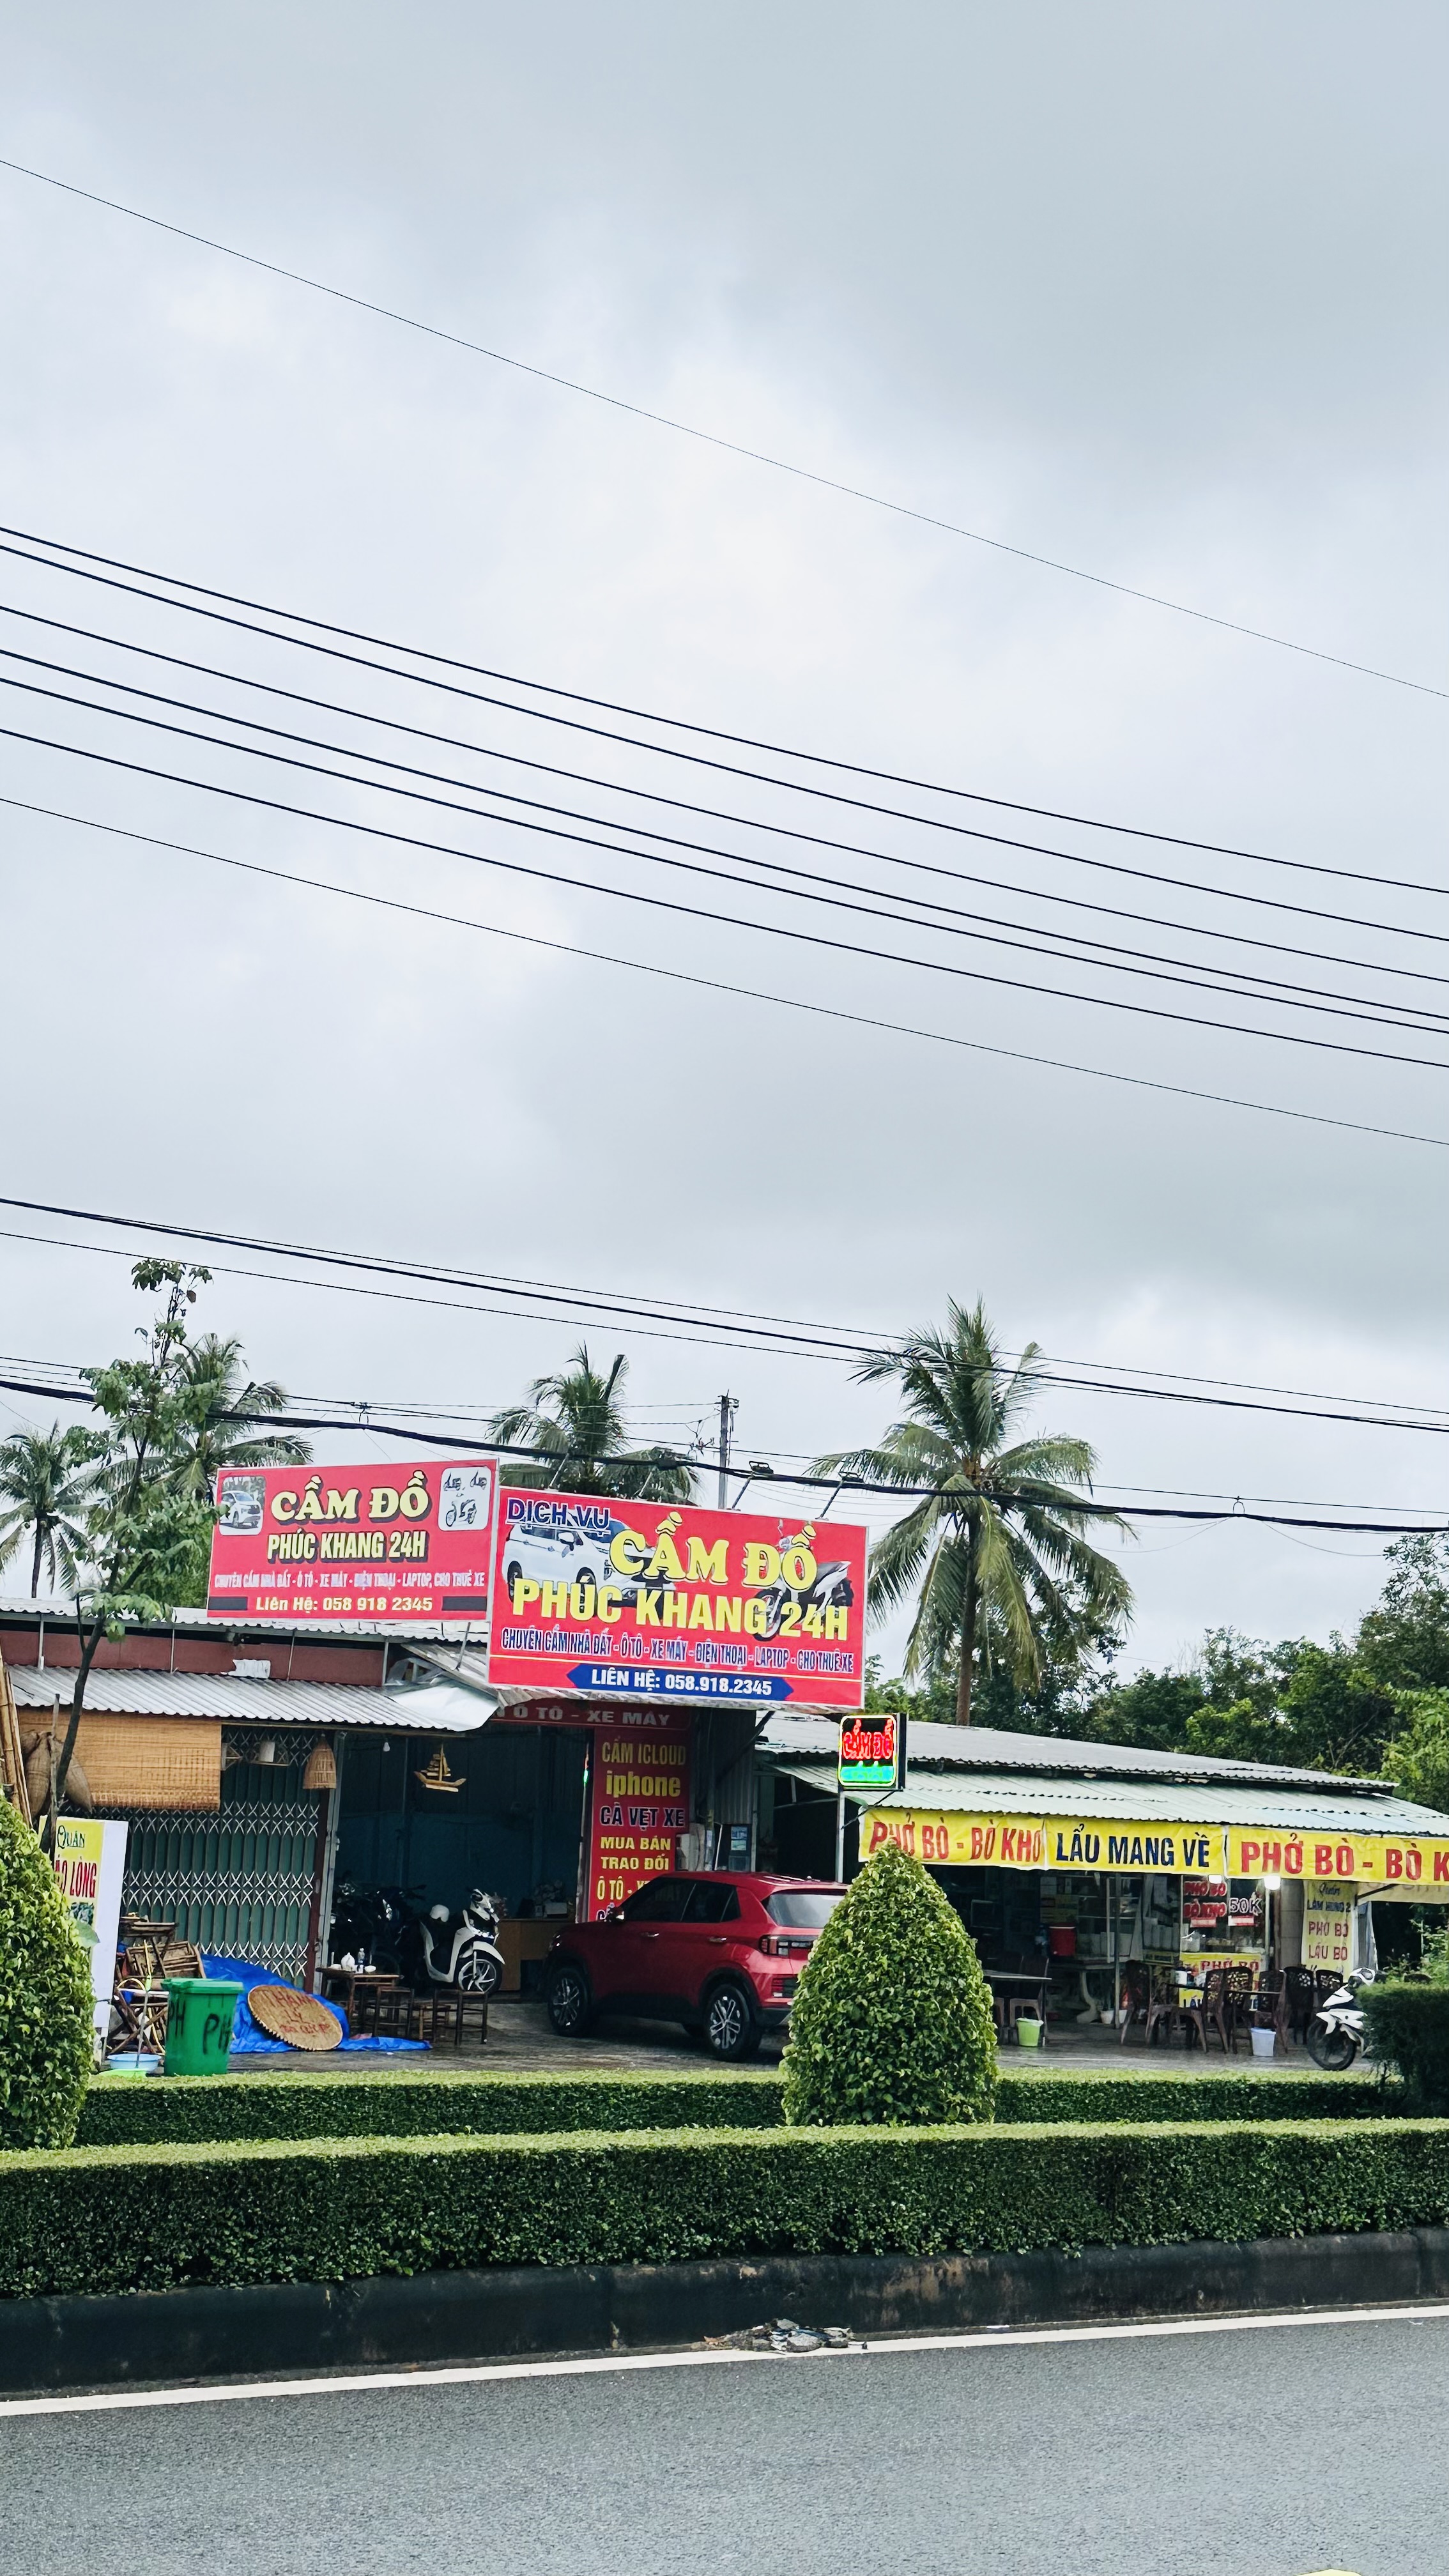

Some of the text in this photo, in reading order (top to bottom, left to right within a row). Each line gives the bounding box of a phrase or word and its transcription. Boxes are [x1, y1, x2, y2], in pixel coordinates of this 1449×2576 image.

[271, 1471, 429, 1522] CẦM ĐỒ
[507, 1498, 611, 1537] DỊCH VỤ
[267, 1528, 427, 1560] PHÚC KHANG 24H
[610, 1511, 818, 1592] CẦM ĐỒ
[256, 1597, 433, 1613] Liên Hệ: 058 918 2345
[513, 1575, 848, 1641] PHÚC KHANG 24H
[501, 1625, 543, 1652] CHUYÊN
[592, 1627, 613, 1657] ĐẤT
[620, 1632, 629, 1658] Ô
[629, 1633, 643, 1659] TÔ
[650, 1638, 664, 1660] XE
[665, 1636, 688, 1662] MÁY
[695, 1638, 719, 1668] ĐIỆN
[720, 1643, 747, 1671] THOẠI
[754, 1646, 790, 1669] LAPTOP
[797, 1648, 816, 1671] CHO
[817, 1648, 841, 1673] THUÊ
[841, 1652, 854, 1674] XE
[592, 1667, 772, 1696] LIÊN HỆ: 058.918.2345
[587, 1710, 615, 1723] XE
[638, 1744, 686, 1765] ICLOUD
[606, 1770, 680, 1798] iphone
[627, 1806, 659, 1831] VẸT
[663, 1807, 685, 1827] XE
[601, 1836, 671, 1850] MUA BÁN
[923, 1817, 949, 1859] BÒ
[970, 1819, 995, 1860] BÒ
[1001, 1827, 1041, 1862] KHO
[1056, 1823, 1210, 1867] LẨU MANG VỀ
[601, 1857, 639, 1869] TRAO
[1241, 1832, 1303, 1874] PHỞ
[1315, 1837, 1354, 1876] BÒ
[1386, 1843, 1422, 1880] BÒ
[70, 1856, 96, 1898] LÒNG
[597, 1876, 624, 1900] Ô TÔ
[1229, 1897, 1262, 1915] 50K
